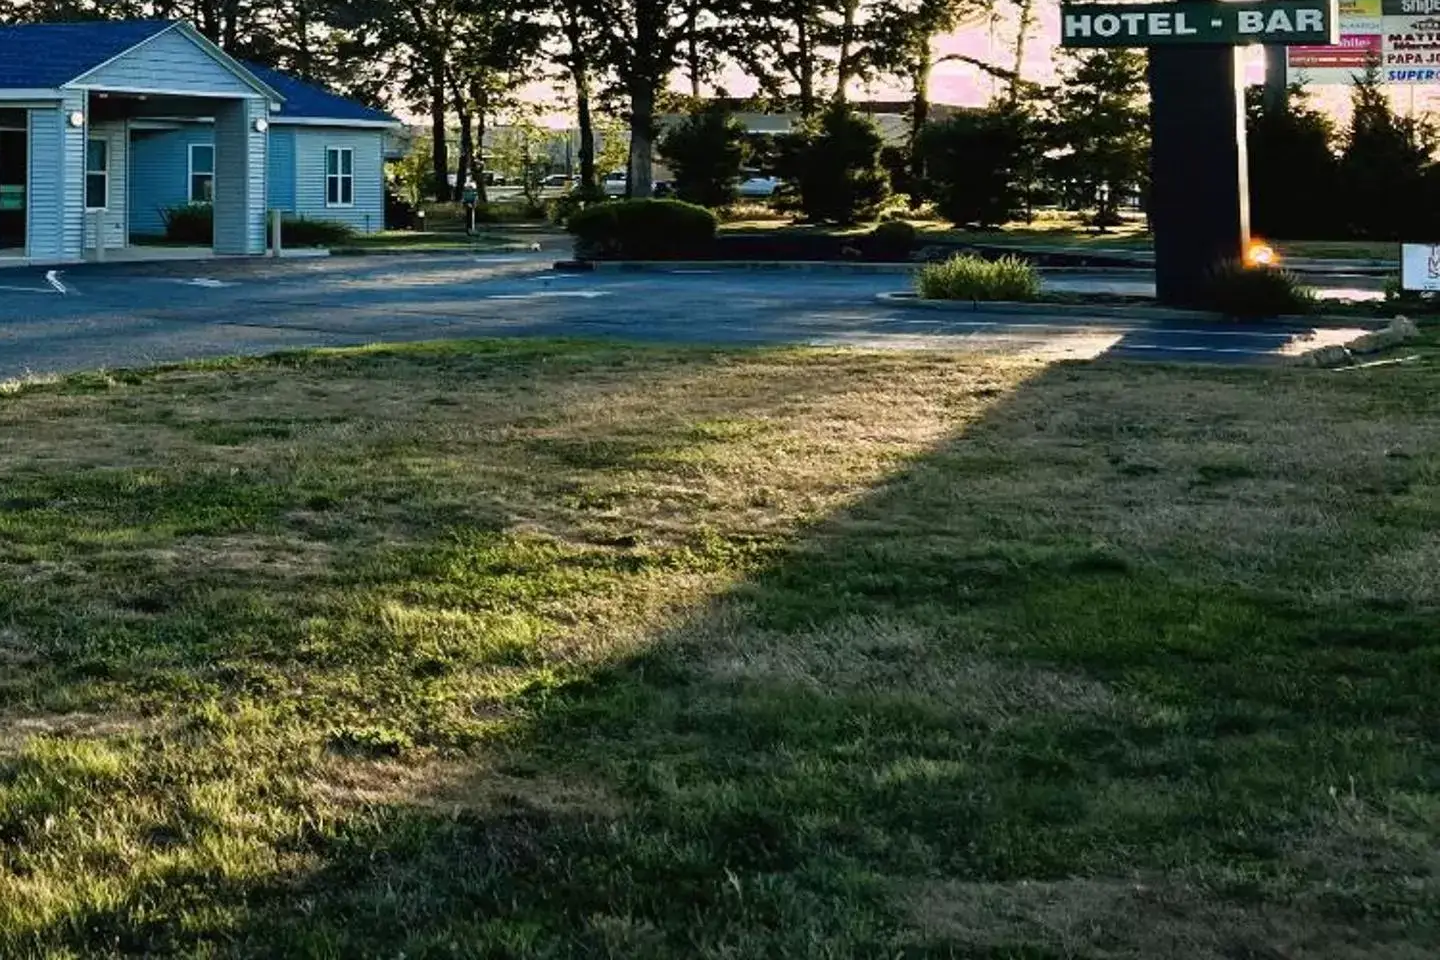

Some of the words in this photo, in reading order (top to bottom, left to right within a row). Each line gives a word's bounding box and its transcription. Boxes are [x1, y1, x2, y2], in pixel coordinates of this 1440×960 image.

[1065, 12, 1197, 38] HOTEL
[1237, 8, 1325, 34] BAR
[1388, 53, 1423, 64] PAPA
